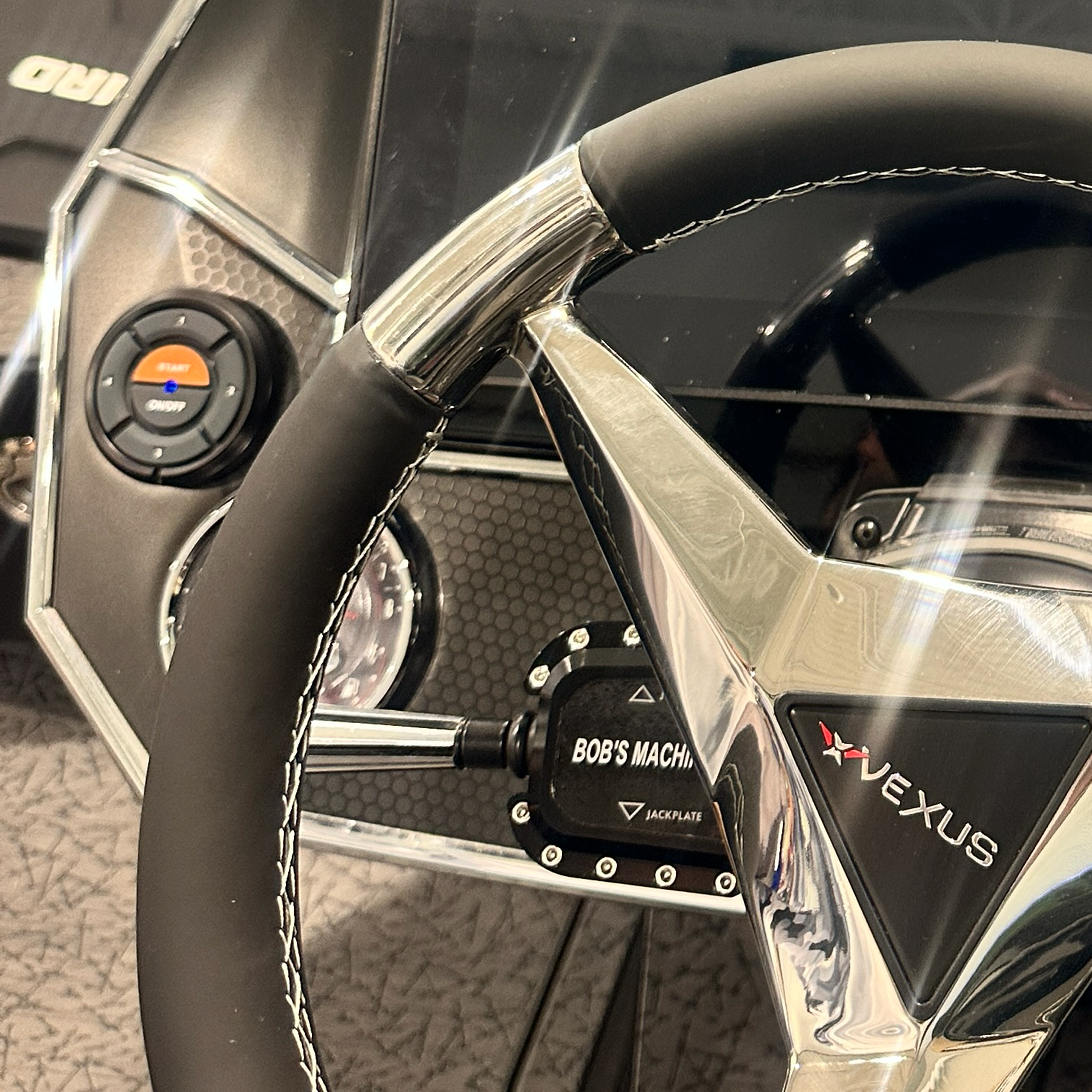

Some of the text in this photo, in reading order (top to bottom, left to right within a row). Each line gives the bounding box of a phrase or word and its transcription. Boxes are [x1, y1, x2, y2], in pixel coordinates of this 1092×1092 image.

[156, 362, 191, 373] START
[145, 398, 187, 413] ON/OFF
[571, 737, 629, 766] BOB'S
[861, 745, 998, 868] VEXUS
[645, 809, 702, 822] JACKPLATE
